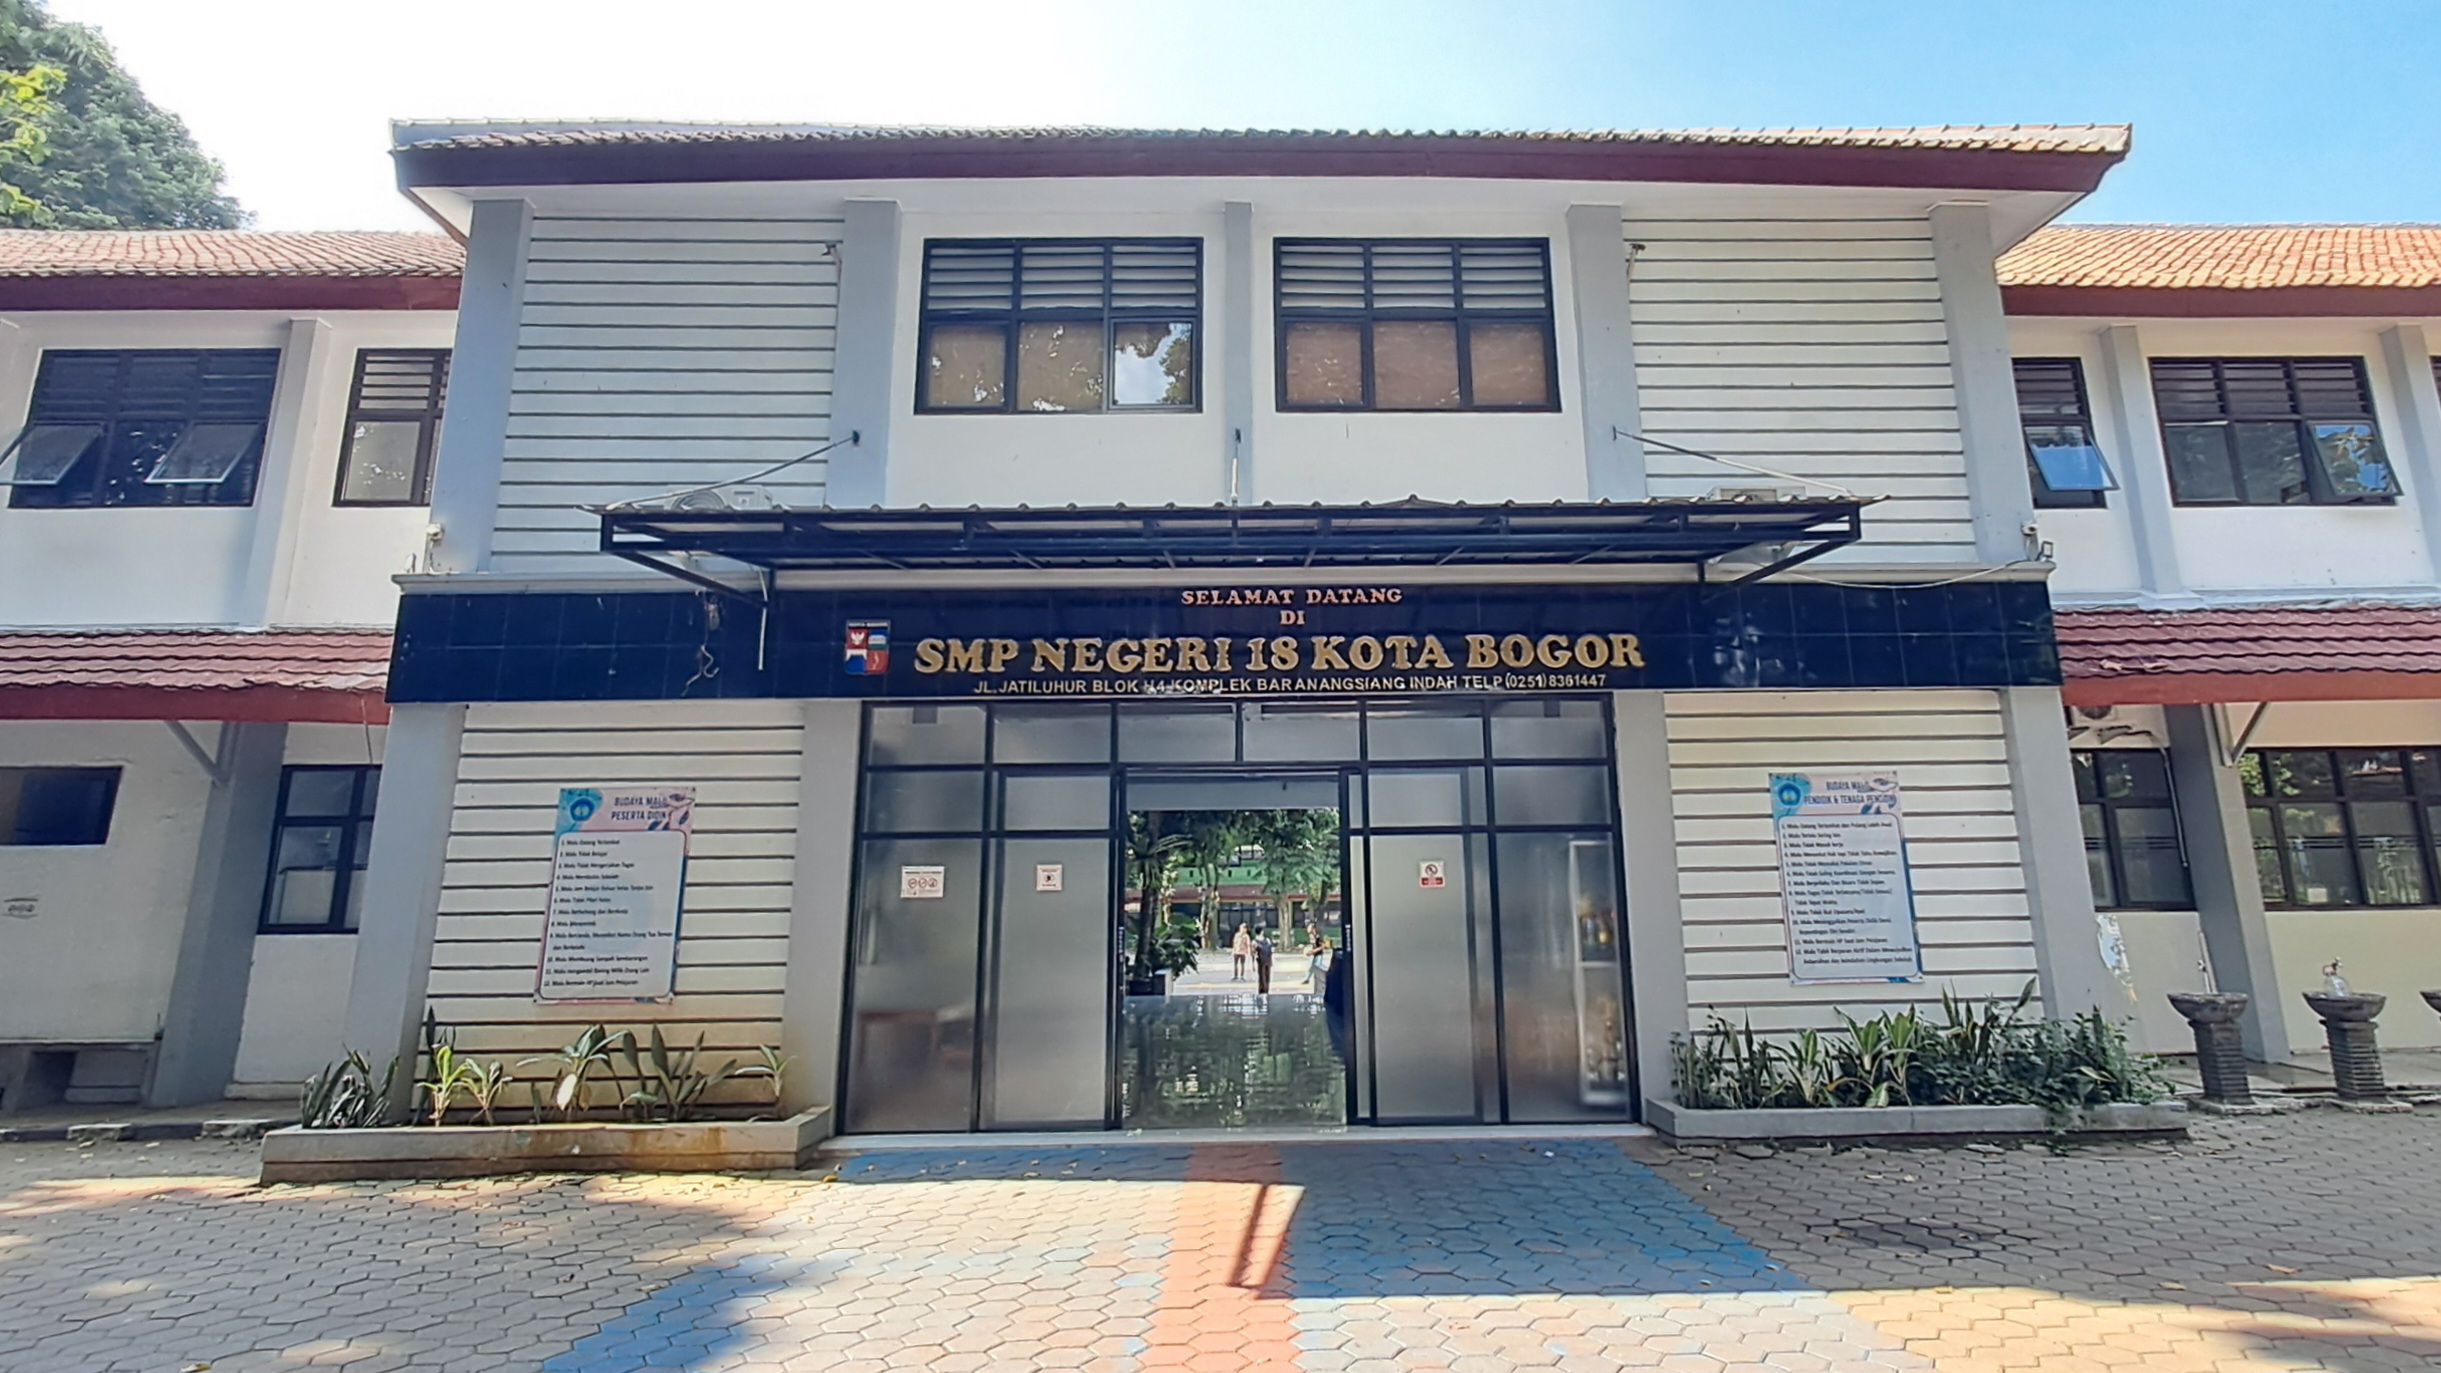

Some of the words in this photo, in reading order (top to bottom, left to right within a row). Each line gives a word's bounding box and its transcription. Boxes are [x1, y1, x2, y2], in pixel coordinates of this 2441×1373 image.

[1181, 590, 1294, 605] SELAMAT
[1306, 588, 1403, 604] DATANG
[1280, 610, 1306, 625] DI
[914, 638, 1019, 673] SMP
[1031, 637, 1232, 673] NEGERI
[1247, 637, 1299, 670] 18
[1311, 635, 1454, 669] KOTA
[1465, 634, 1645, 668] BOGOR
[1093, 680, 1139, 693] BLOK
[1172, 678, 1252, 693] KOMPLEK
[1257, 677, 1405, 692] BARANANGSIANG
[1409, 676, 1459, 690] INDAH
[1462, 675, 1503, 689] TELP
[611, 811, 645, 820] PESERTA
